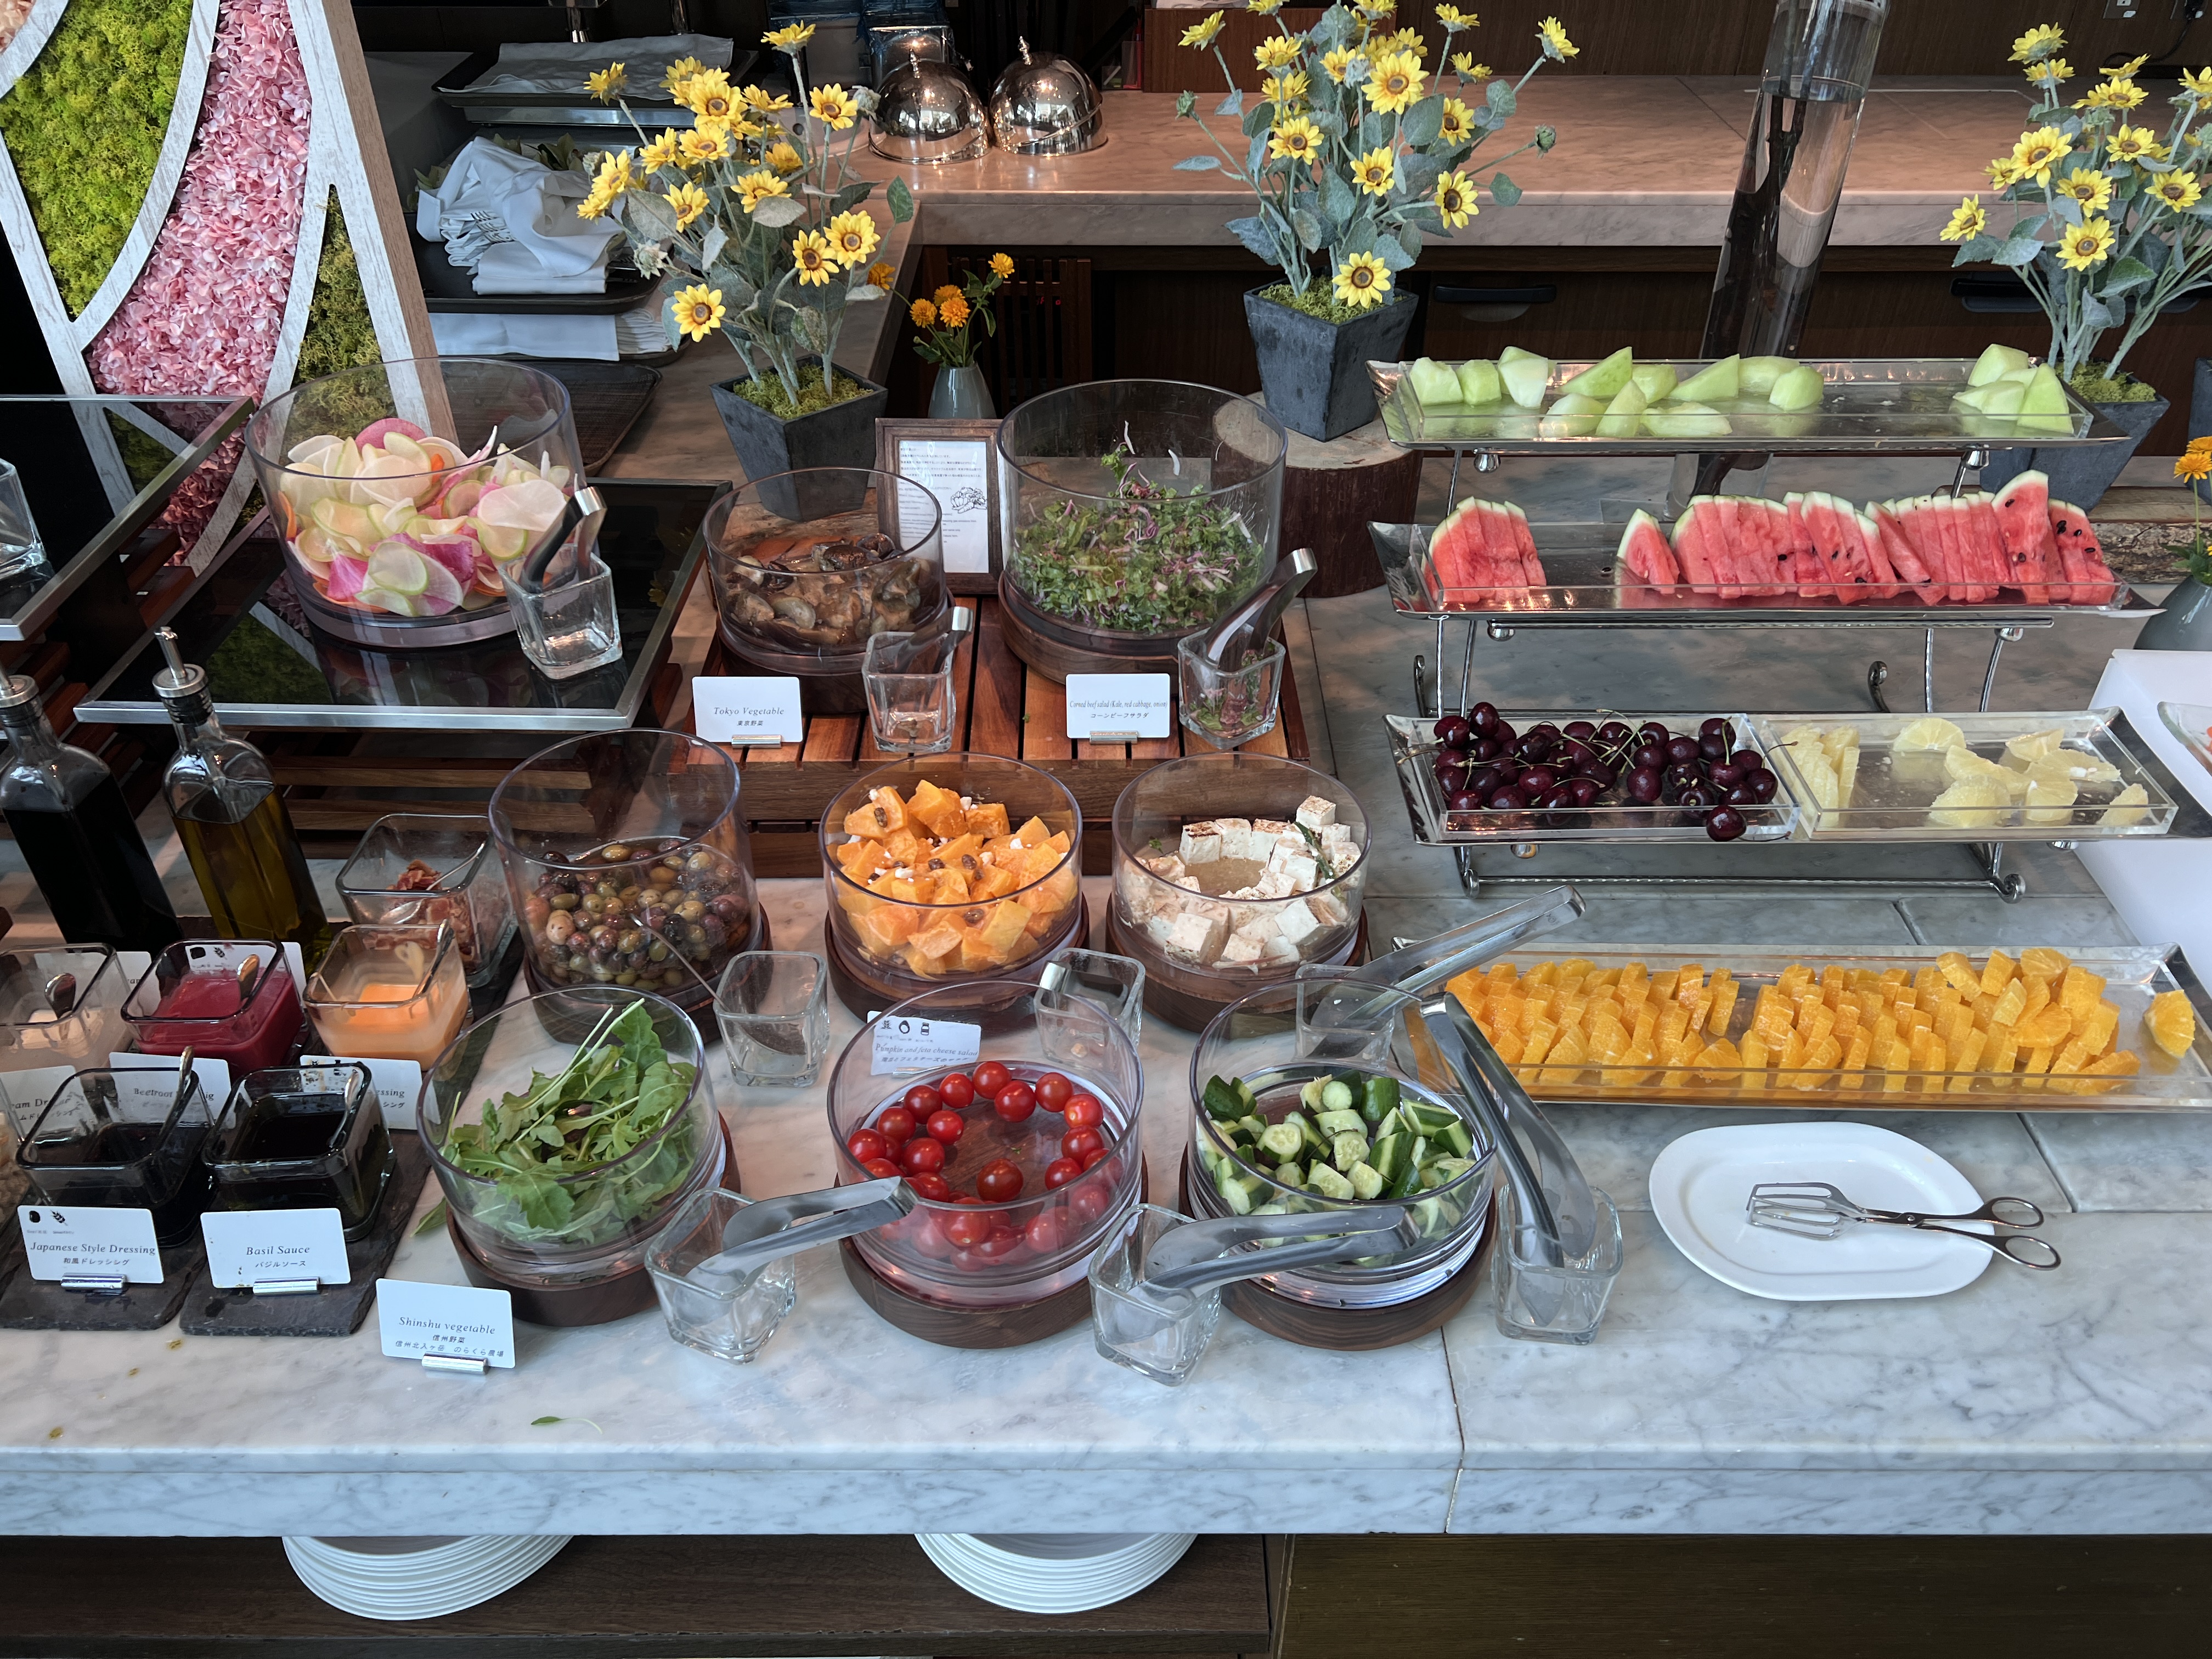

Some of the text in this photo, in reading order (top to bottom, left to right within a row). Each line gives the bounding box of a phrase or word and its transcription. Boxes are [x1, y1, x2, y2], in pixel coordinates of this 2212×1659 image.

[1087, 700, 1098, 709] beef
[1153, 700, 1167, 708] onion)
[714, 707, 785, 716] Tokyo Vegetable
[133, 1088, 173, 1098] Beetroot
[30, 1242, 155, 1256] Japanese Style Dressing
[246, 1245, 310, 1255] Basil Sauce
[63, 1257, 130, 1266] 和風ドレッシング
[399, 1317, 495, 1334] Shinshu vegetable
[432, 1334, 466, 1344] 信州野菜
